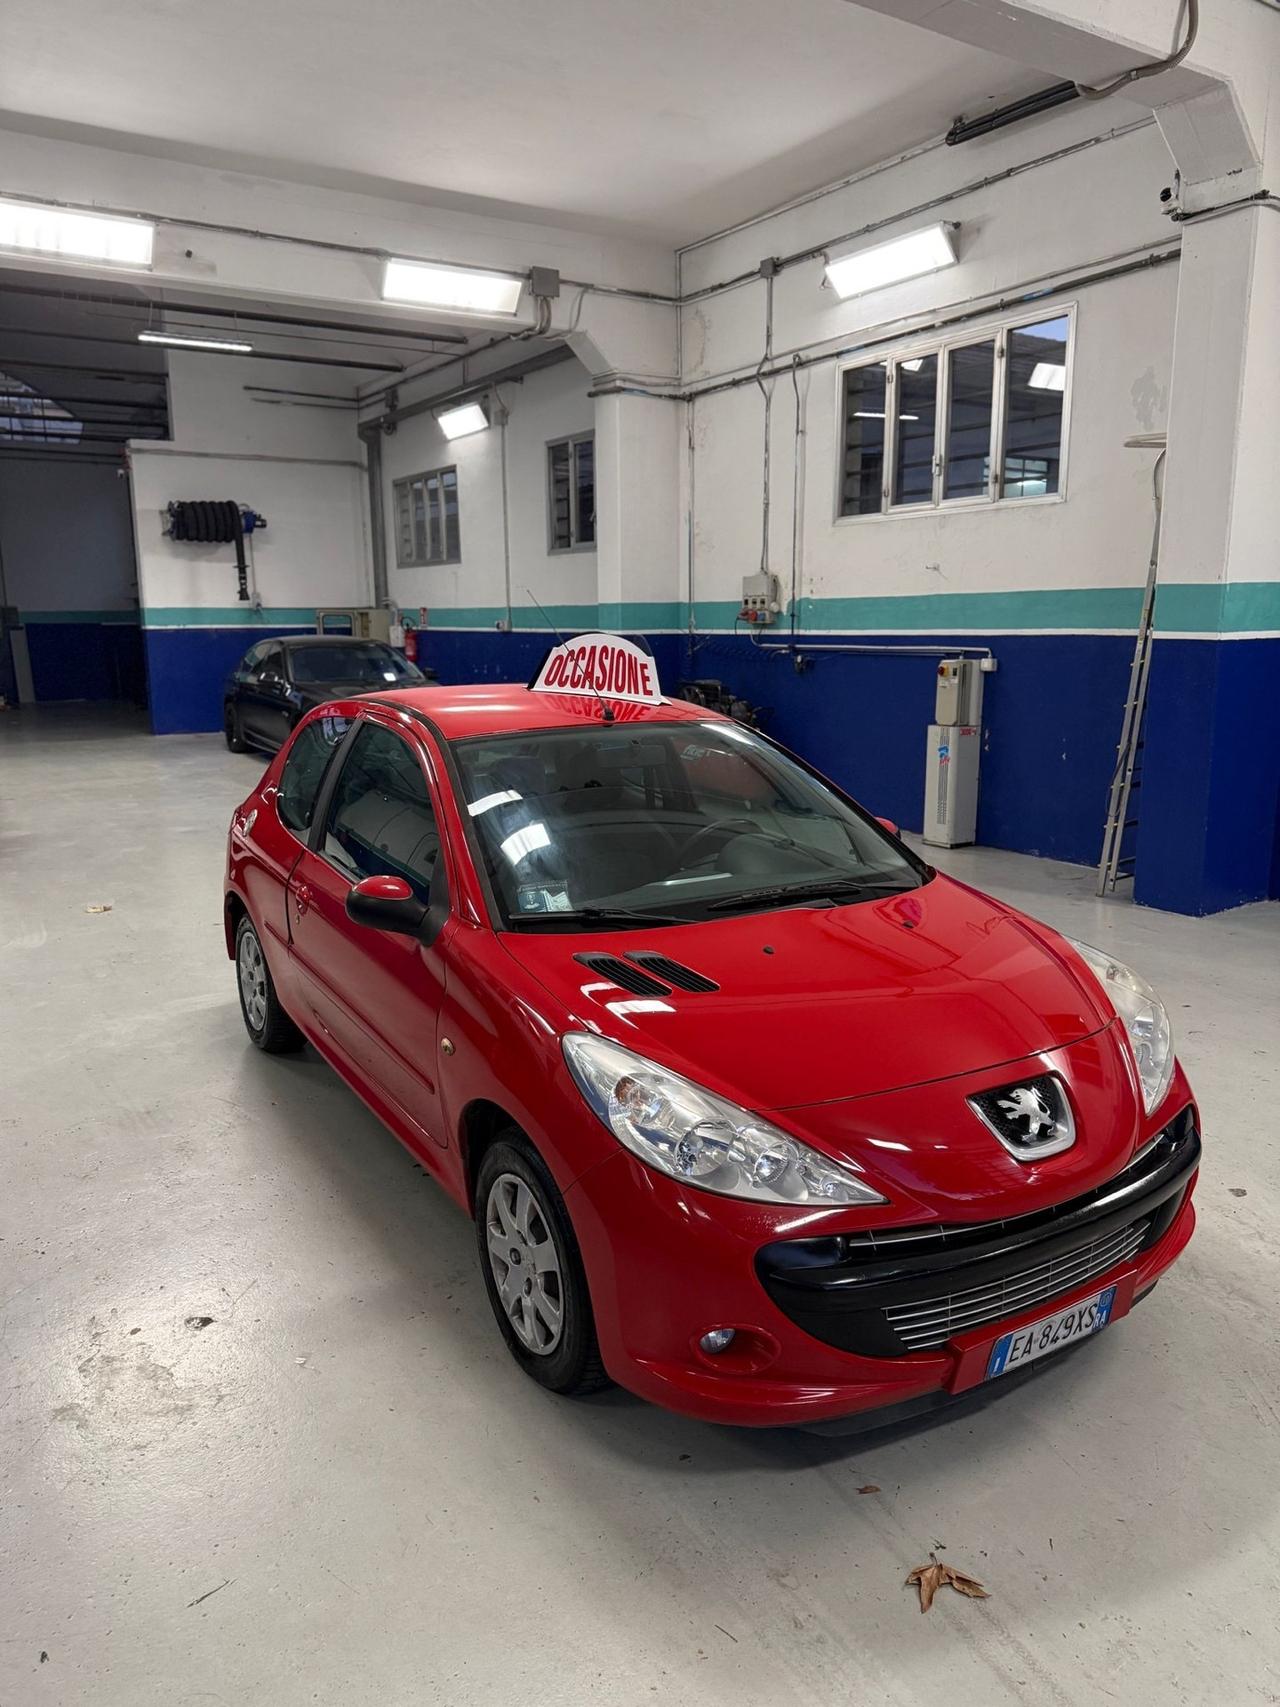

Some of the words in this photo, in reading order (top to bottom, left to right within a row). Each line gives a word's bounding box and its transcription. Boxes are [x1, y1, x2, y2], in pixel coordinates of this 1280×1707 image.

[544, 645, 654, 696] OCCASIONE
[1009, 1332, 1034, 1363] EA
[1040, 1303, 1098, 1350] 849XS
[1093, 1309, 1107, 1330] RA
